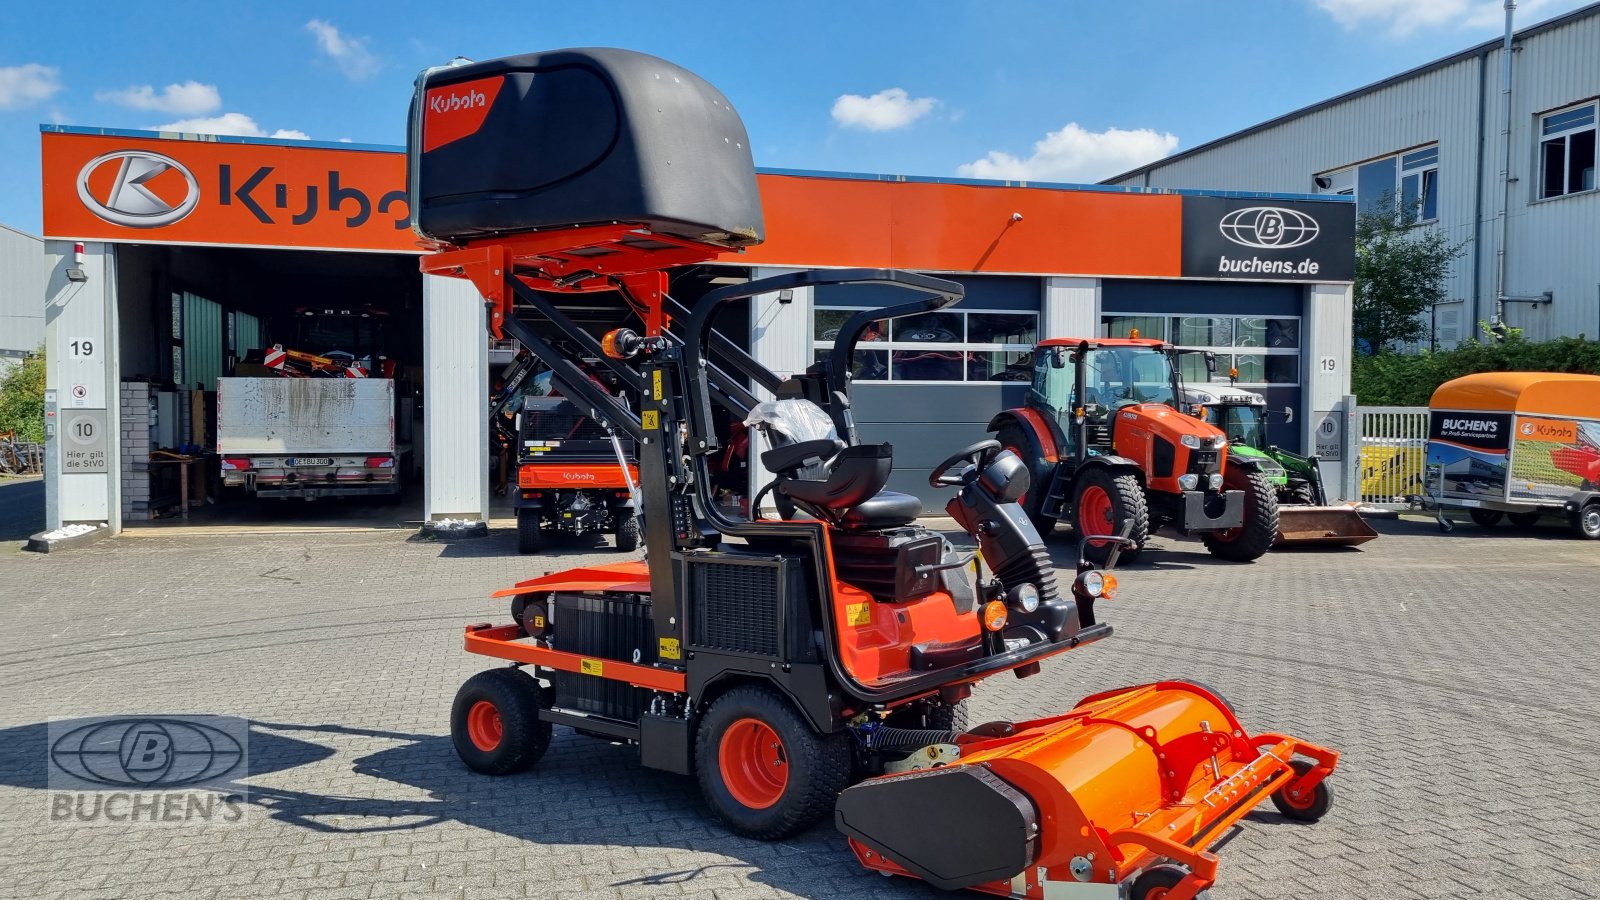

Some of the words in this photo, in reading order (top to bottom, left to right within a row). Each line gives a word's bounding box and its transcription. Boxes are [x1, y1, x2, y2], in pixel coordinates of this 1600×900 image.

[431, 89, 486, 114] Kubota
[219, 164, 412, 231] Kubo
[1218, 255, 1320, 275] buchens.de
[70, 340, 94, 356] 19
[1321, 358, 1336, 371] 19
[76, 423, 93, 437] 10
[1322, 422, 1333, 433] 10
[1442, 418, 1498, 432] BUCHEN'S
[1536, 424, 1572, 438] Kubota
[66, 451, 86, 459] Hier
[89, 451, 104, 460] gilt
[66, 459, 80, 468] die
[83, 459, 105, 468] StVO
[563, 472, 595, 480] Kubota
